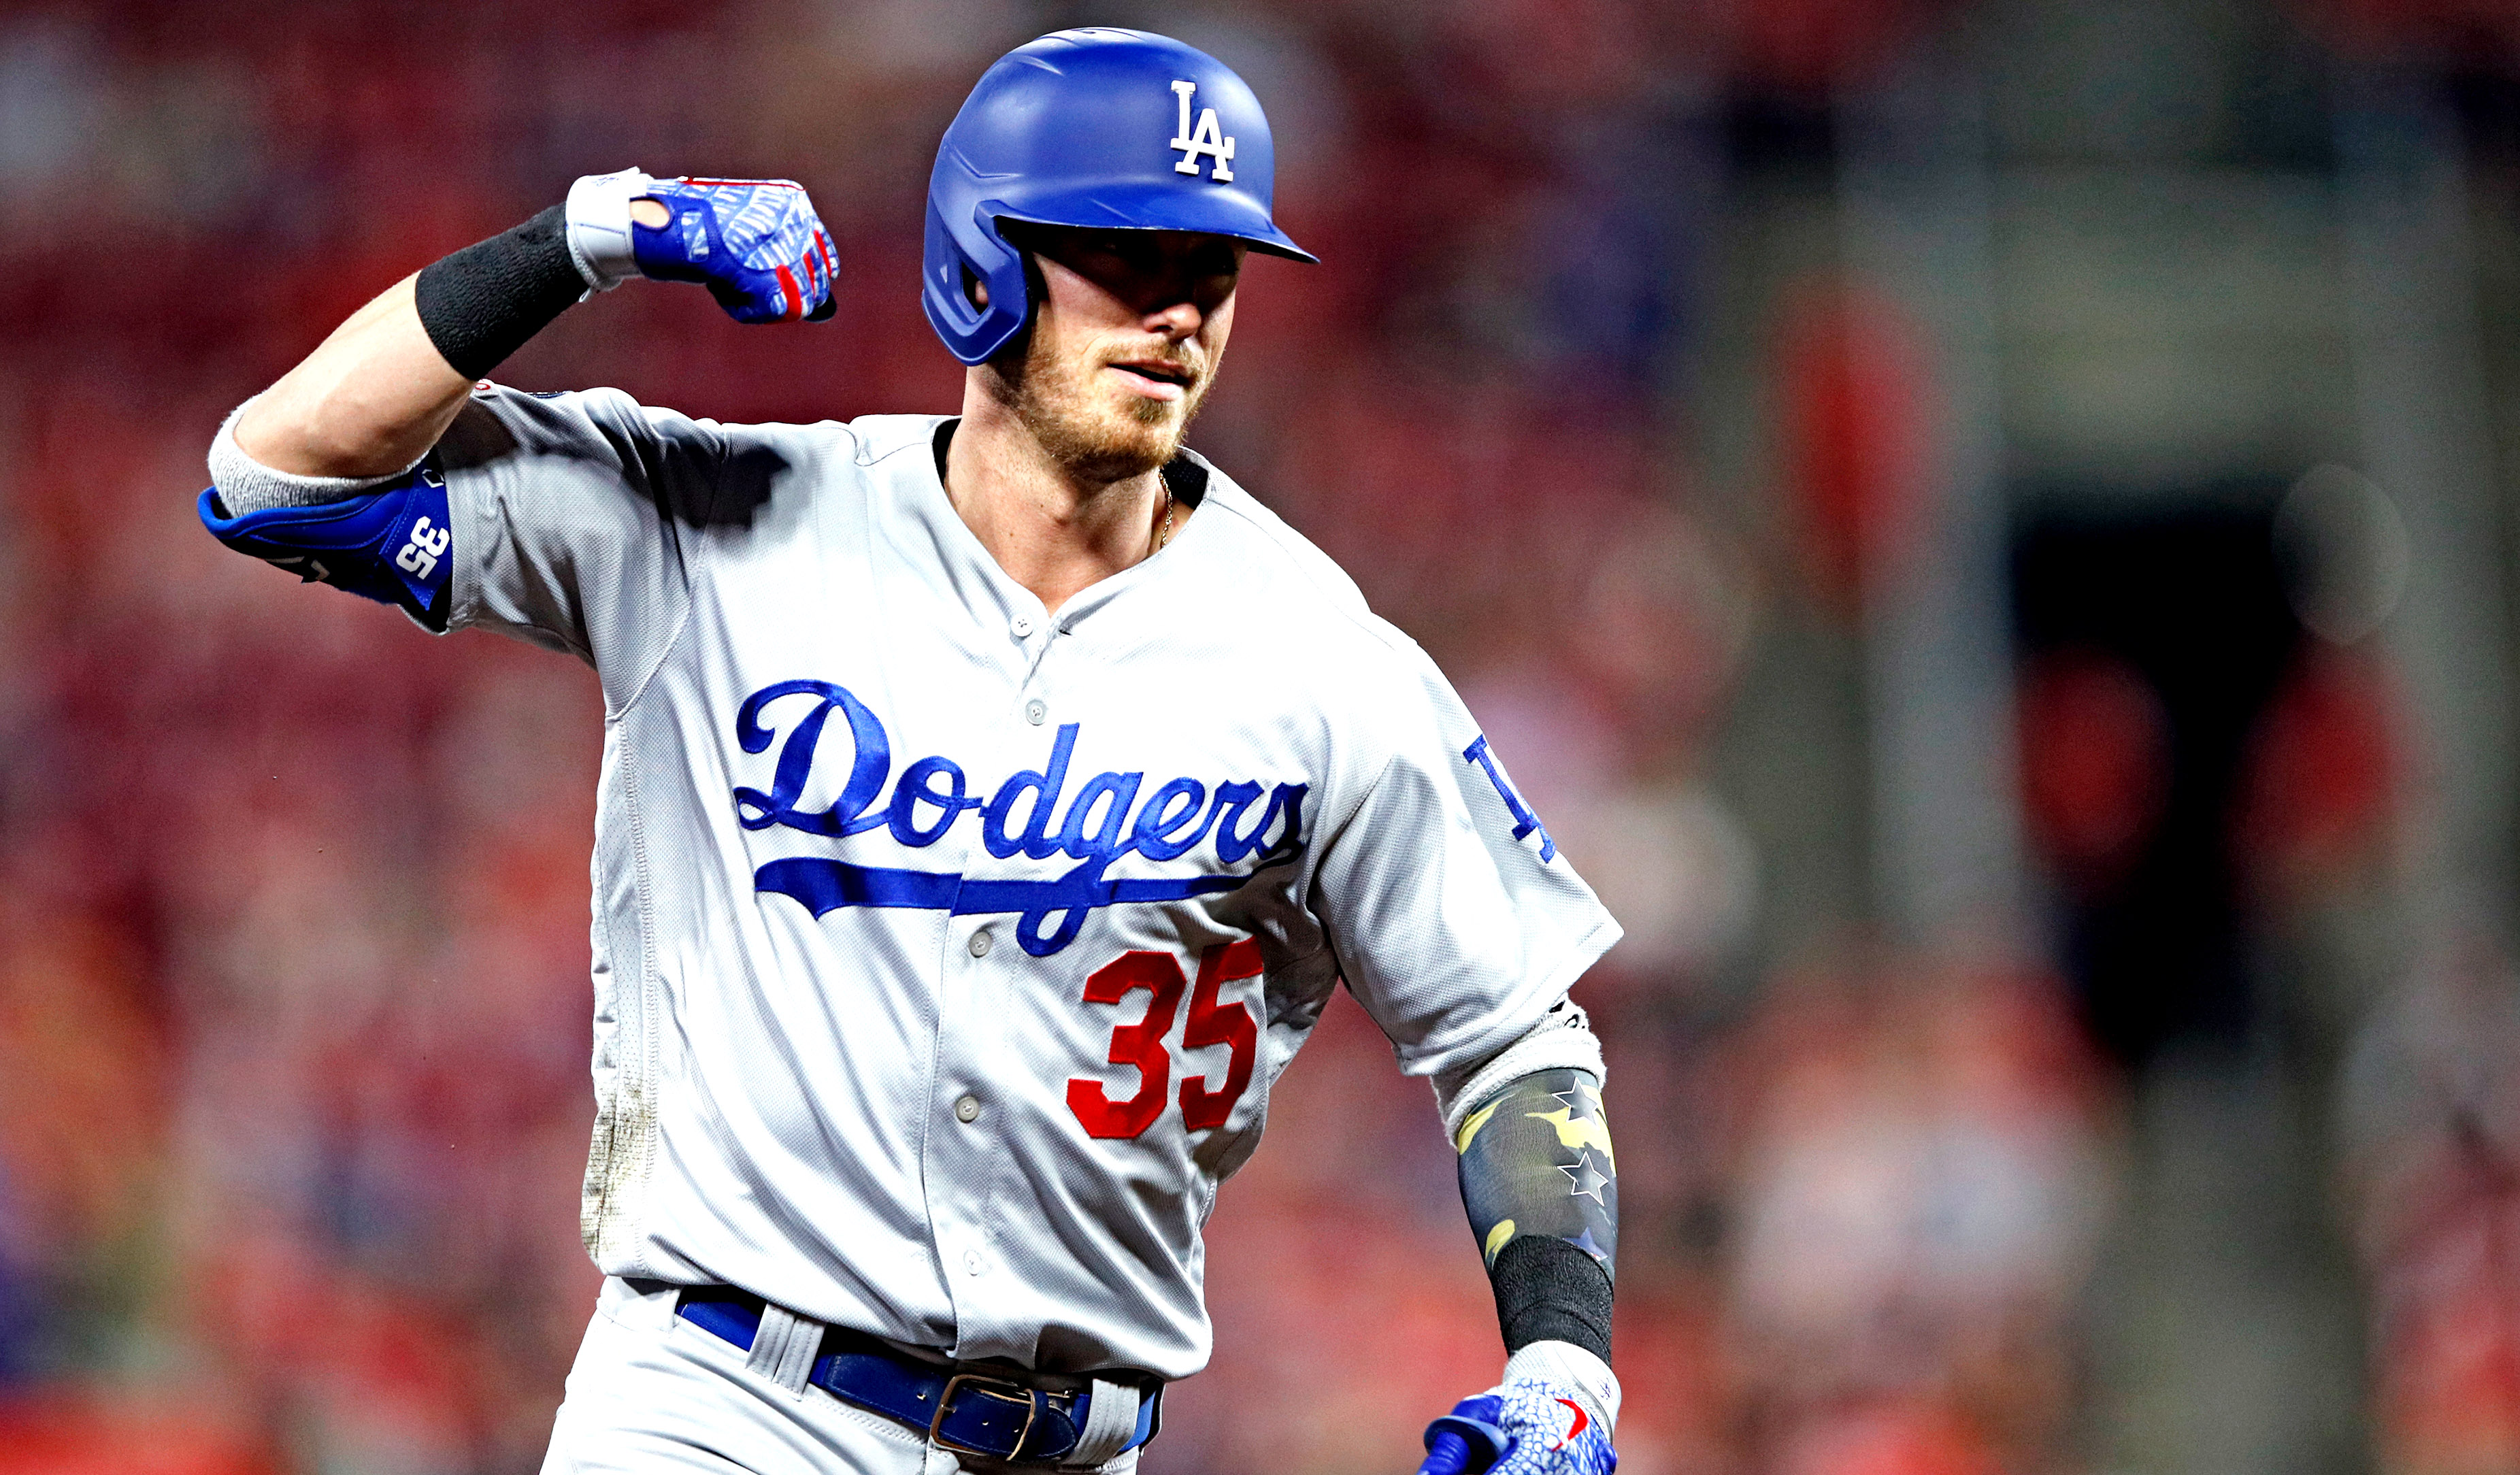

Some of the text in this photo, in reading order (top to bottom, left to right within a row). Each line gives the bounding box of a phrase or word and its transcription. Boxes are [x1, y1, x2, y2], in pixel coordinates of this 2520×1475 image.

[1170, 80, 1236, 182] LA
[396, 516, 450, 580] 35
[733, 679, 1310, 957] Dodgers
[1066, 935, 1265, 1140] 35
